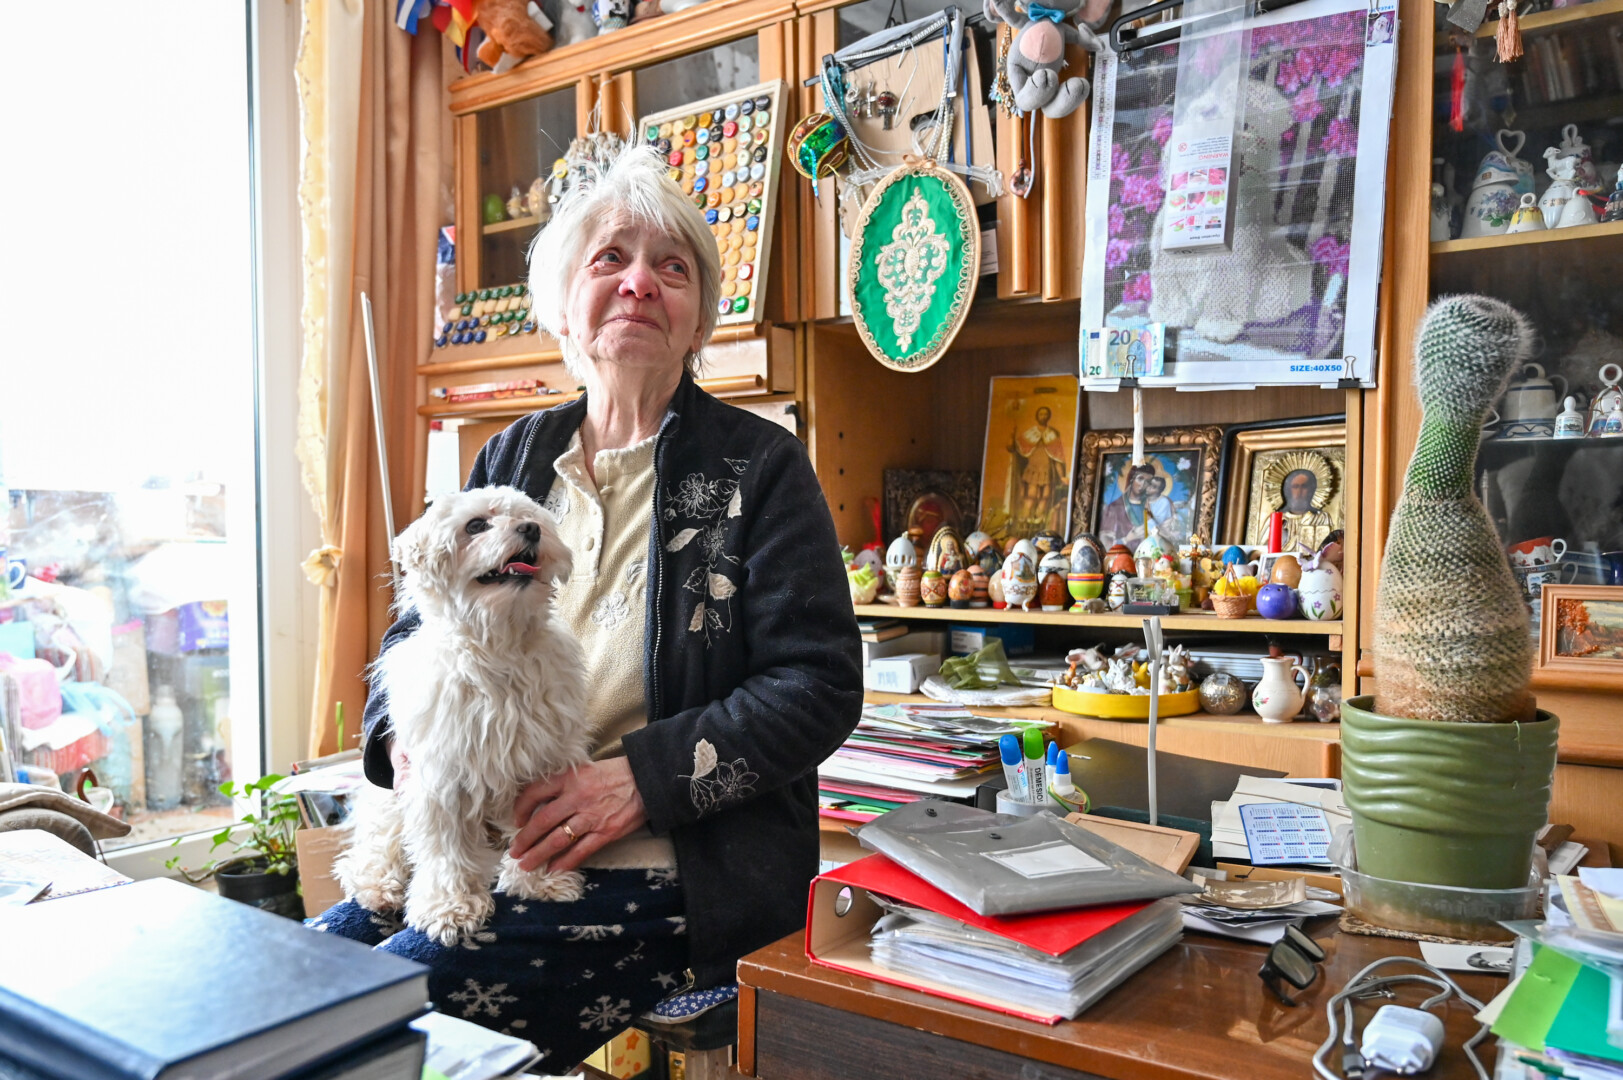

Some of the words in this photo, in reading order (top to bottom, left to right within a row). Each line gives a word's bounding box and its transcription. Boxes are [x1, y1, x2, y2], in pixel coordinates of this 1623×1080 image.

[1199, 153, 1229, 161] WARNING
[1110, 330, 1131, 345] 20
[1089, 366, 1102, 376] 20
[1290, 364, 1342, 372] SIZE:40X50
